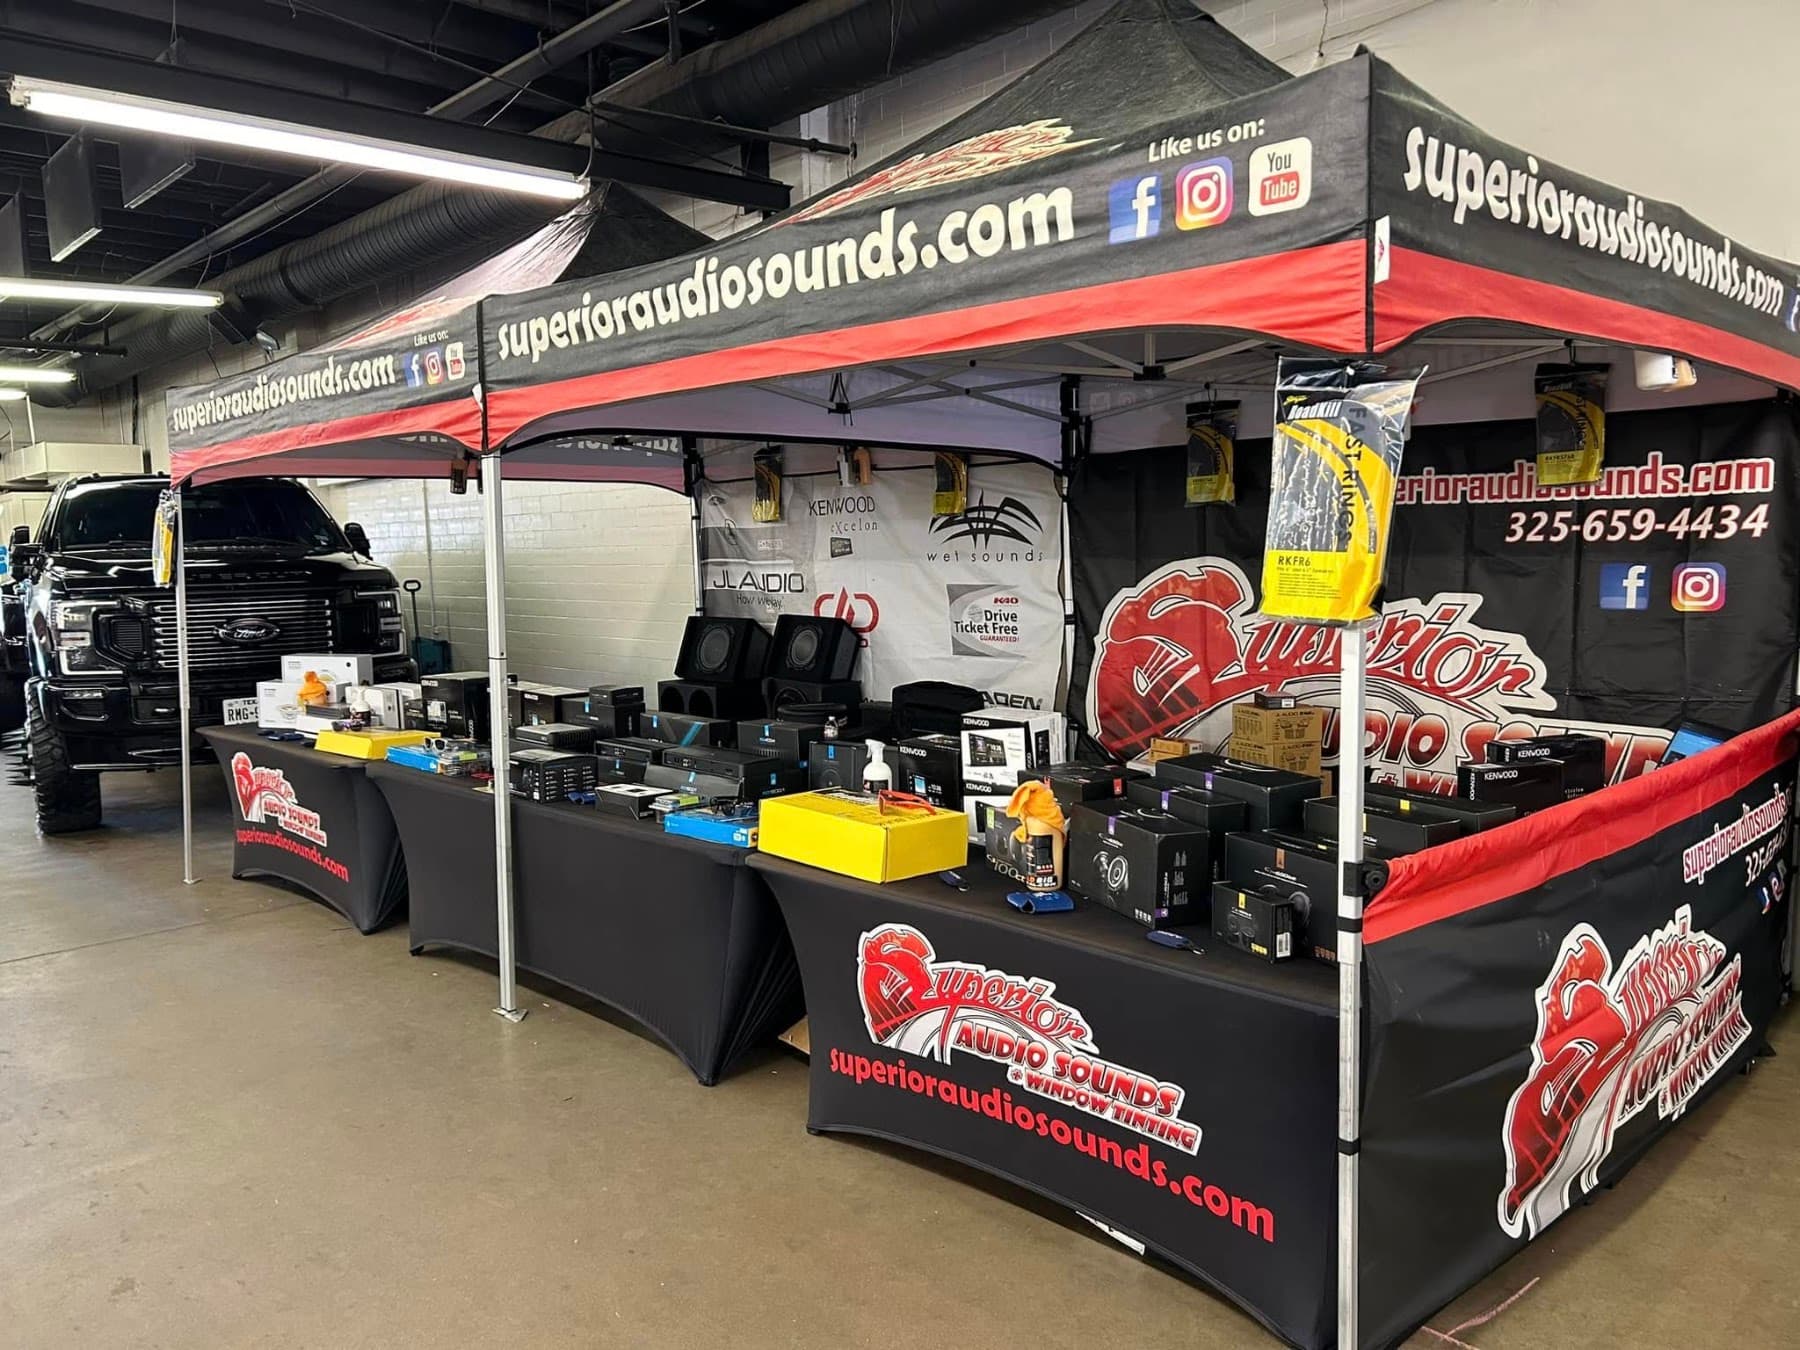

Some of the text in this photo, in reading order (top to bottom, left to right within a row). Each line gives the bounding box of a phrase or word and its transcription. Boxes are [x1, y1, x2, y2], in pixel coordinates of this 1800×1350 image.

[1148, 119, 1265, 163] Like us on:
[1267, 153, 1292, 173] You
[1263, 176, 1297, 200] Tube
[1404, 126, 1784, 317] superioraudiosounds.com
[498, 186, 1075, 362] superioraudiosounds.com
[172, 354, 396, 435] superioraudiosounds.com
[1337, 407, 1367, 542] FAST RINGS
[808, 496, 876, 516] KENWOOD
[1505, 503, 1770, 543] 325-659-4434
[927, 549, 1044, 562] wet sounds
[1278, 555, 1311, 567] RKFR6
[984, 610, 1018, 622] Drive
[954, 621, 1018, 635] Ticket Free
[980, 635, 1020, 643] GUARANTEED!
[963, 717, 990, 727] KENWOOD
[900, 746, 927, 757] KENWOOD
[1518, 748, 1550, 758] KENWOOD
[1485, 770, 1518, 781] KENWOOD
[236, 826, 349, 883] superioraudiosounds.com
[956, 1021, 1179, 1118] AUDIO SOUNDS
[1023, 1071, 1112, 1115] WINDOW
[1111, 1101, 1198, 1151] TINTING
[829, 1046, 1275, 1243] superioraudiosounds.com
